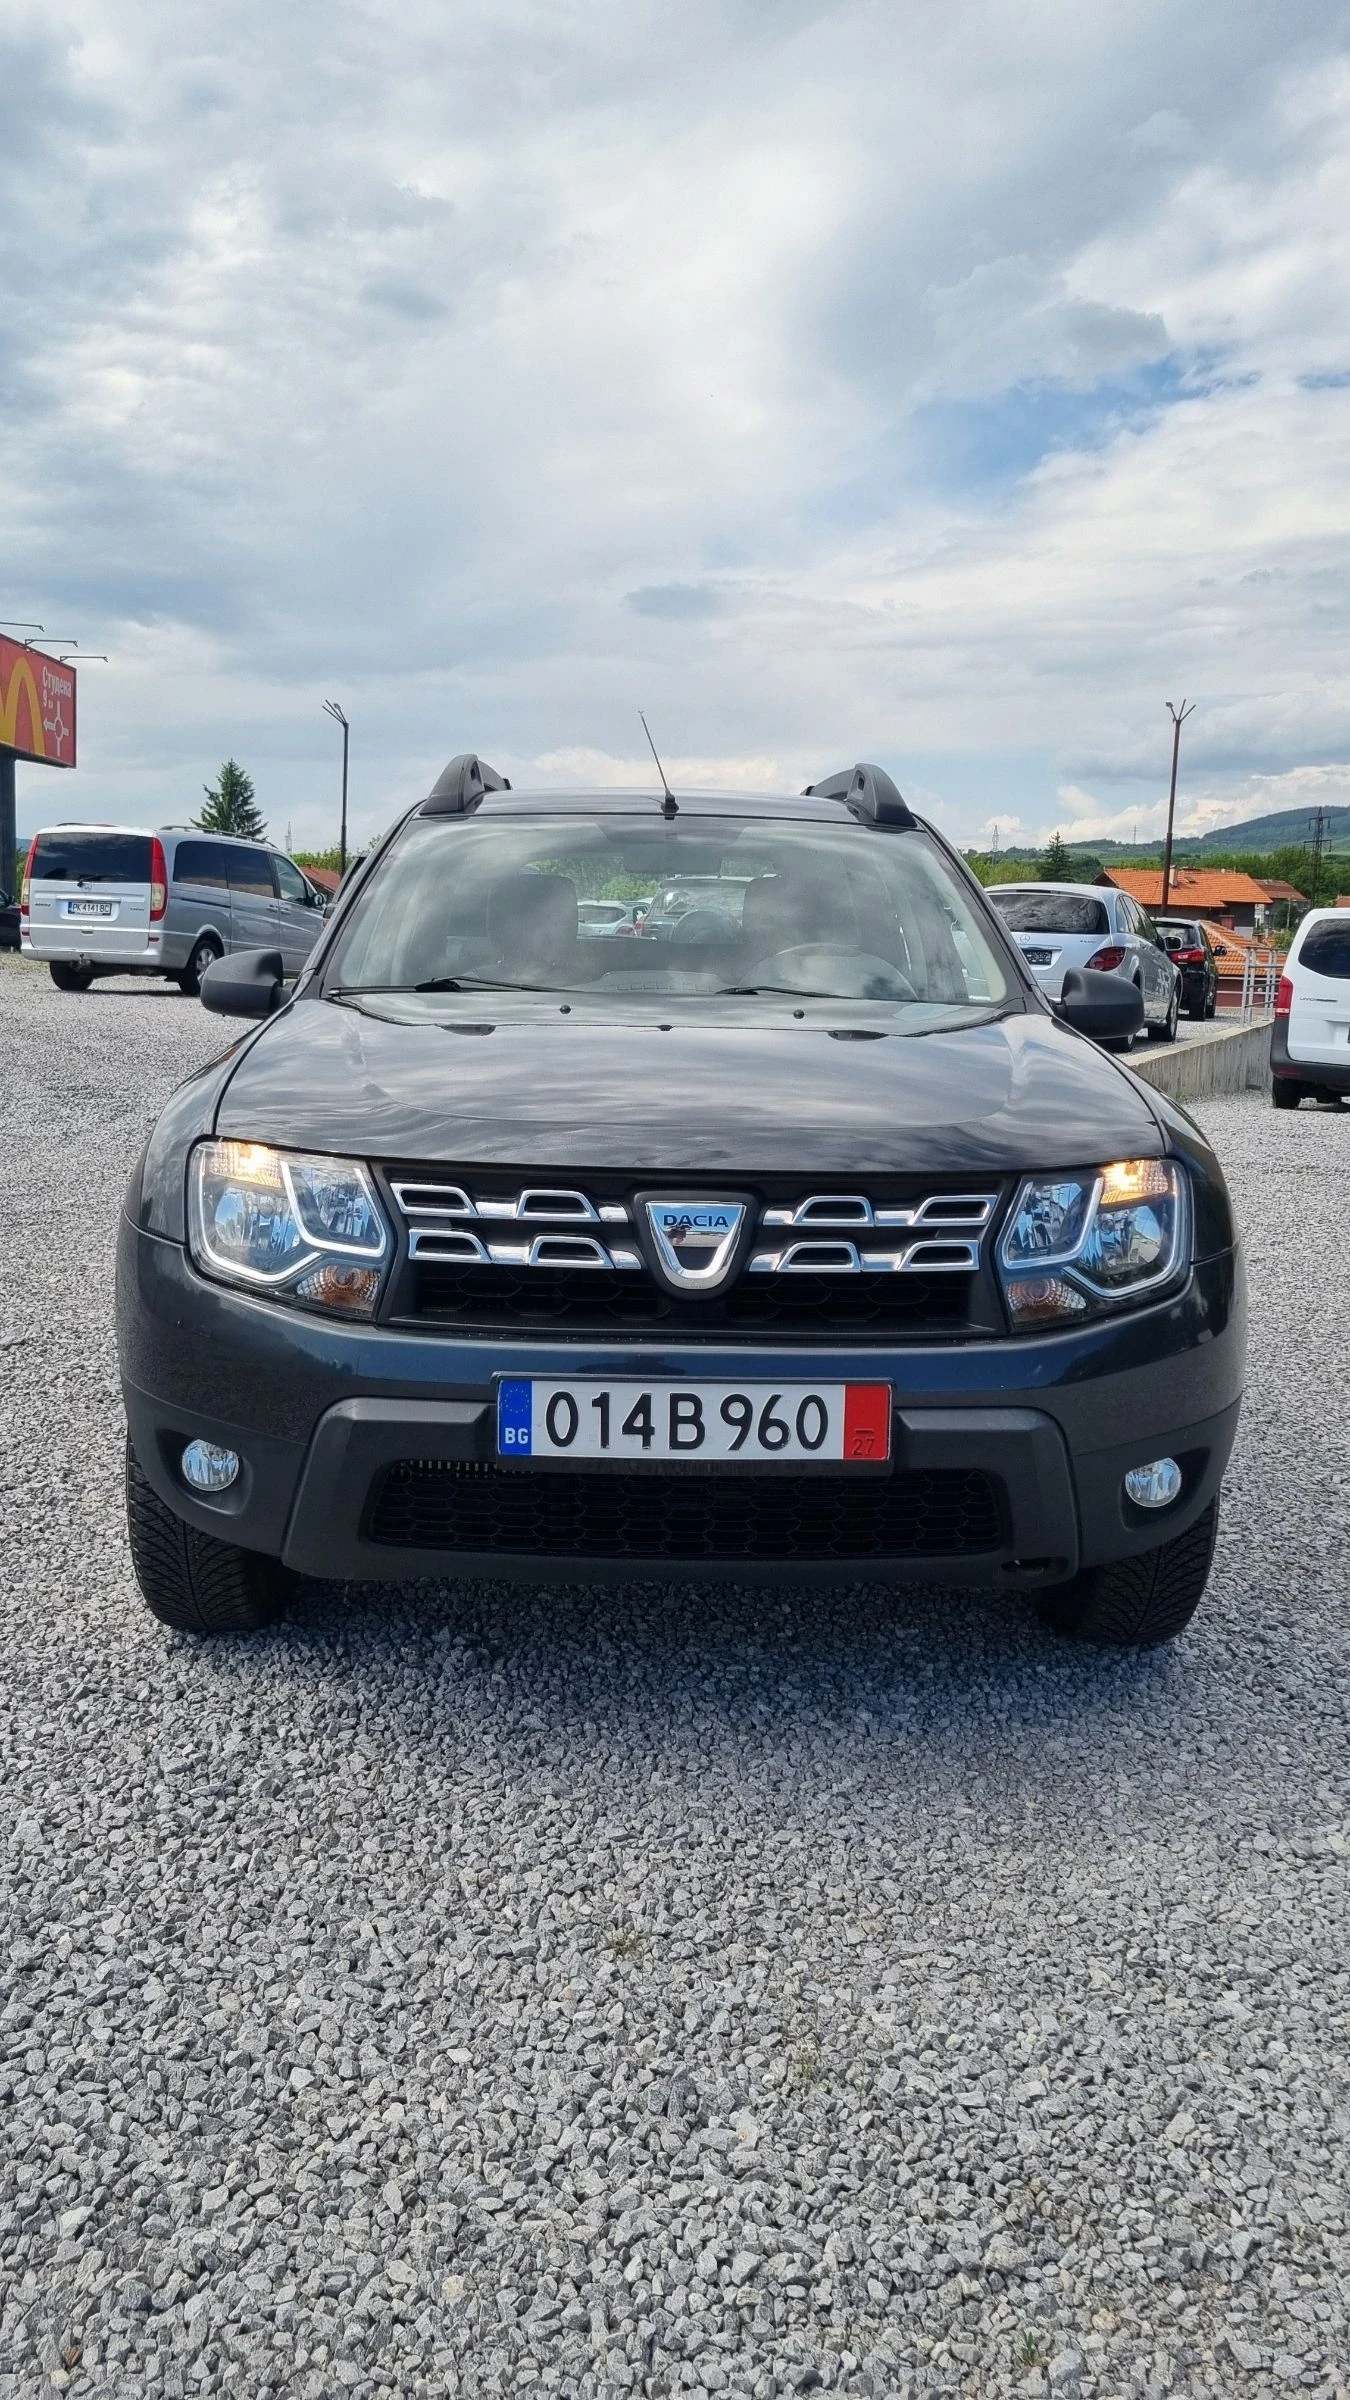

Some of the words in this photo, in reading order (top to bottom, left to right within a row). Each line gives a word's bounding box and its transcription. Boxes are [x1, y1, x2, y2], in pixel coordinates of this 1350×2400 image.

[663, 1214, 729, 1227] DACIA
[504, 1427, 529, 1445] BG
[852, 1437, 876, 1456] 27
